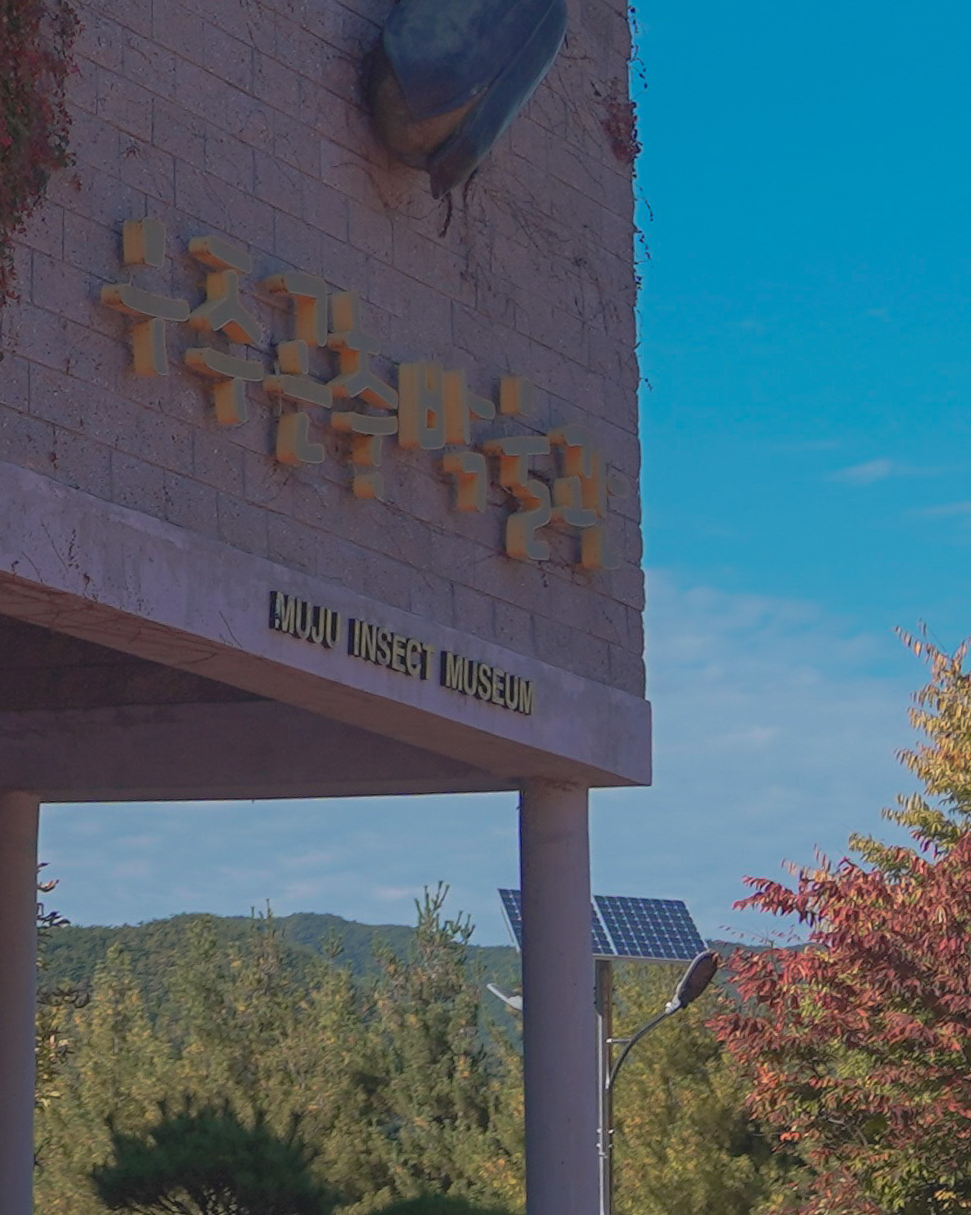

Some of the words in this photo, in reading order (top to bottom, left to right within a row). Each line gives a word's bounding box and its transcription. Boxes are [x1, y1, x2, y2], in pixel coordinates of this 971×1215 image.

[271, 591, 341, 648] MUJU
[350, 618, 434, 679] INSECT
[441, 651, 533, 714] MUSEUM
